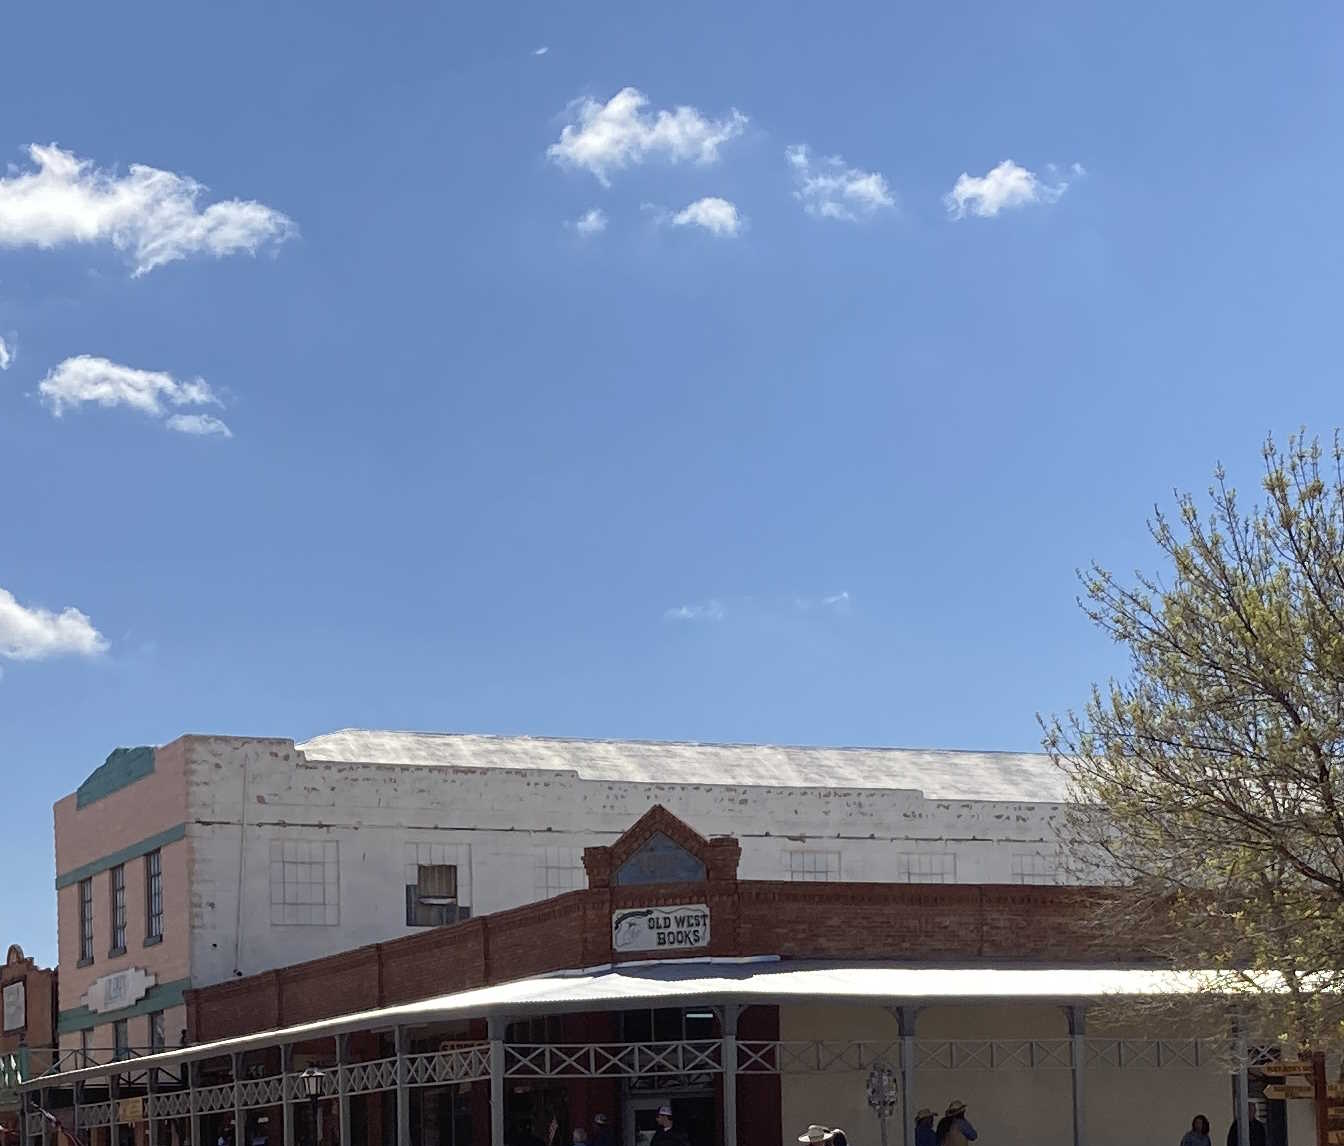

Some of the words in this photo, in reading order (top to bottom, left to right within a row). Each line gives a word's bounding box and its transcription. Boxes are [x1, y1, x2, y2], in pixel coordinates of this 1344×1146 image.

[648, 916, 671, 930] OLD
[674, 914, 708, 929] WEST
[656, 929, 700, 946] BOOKS
